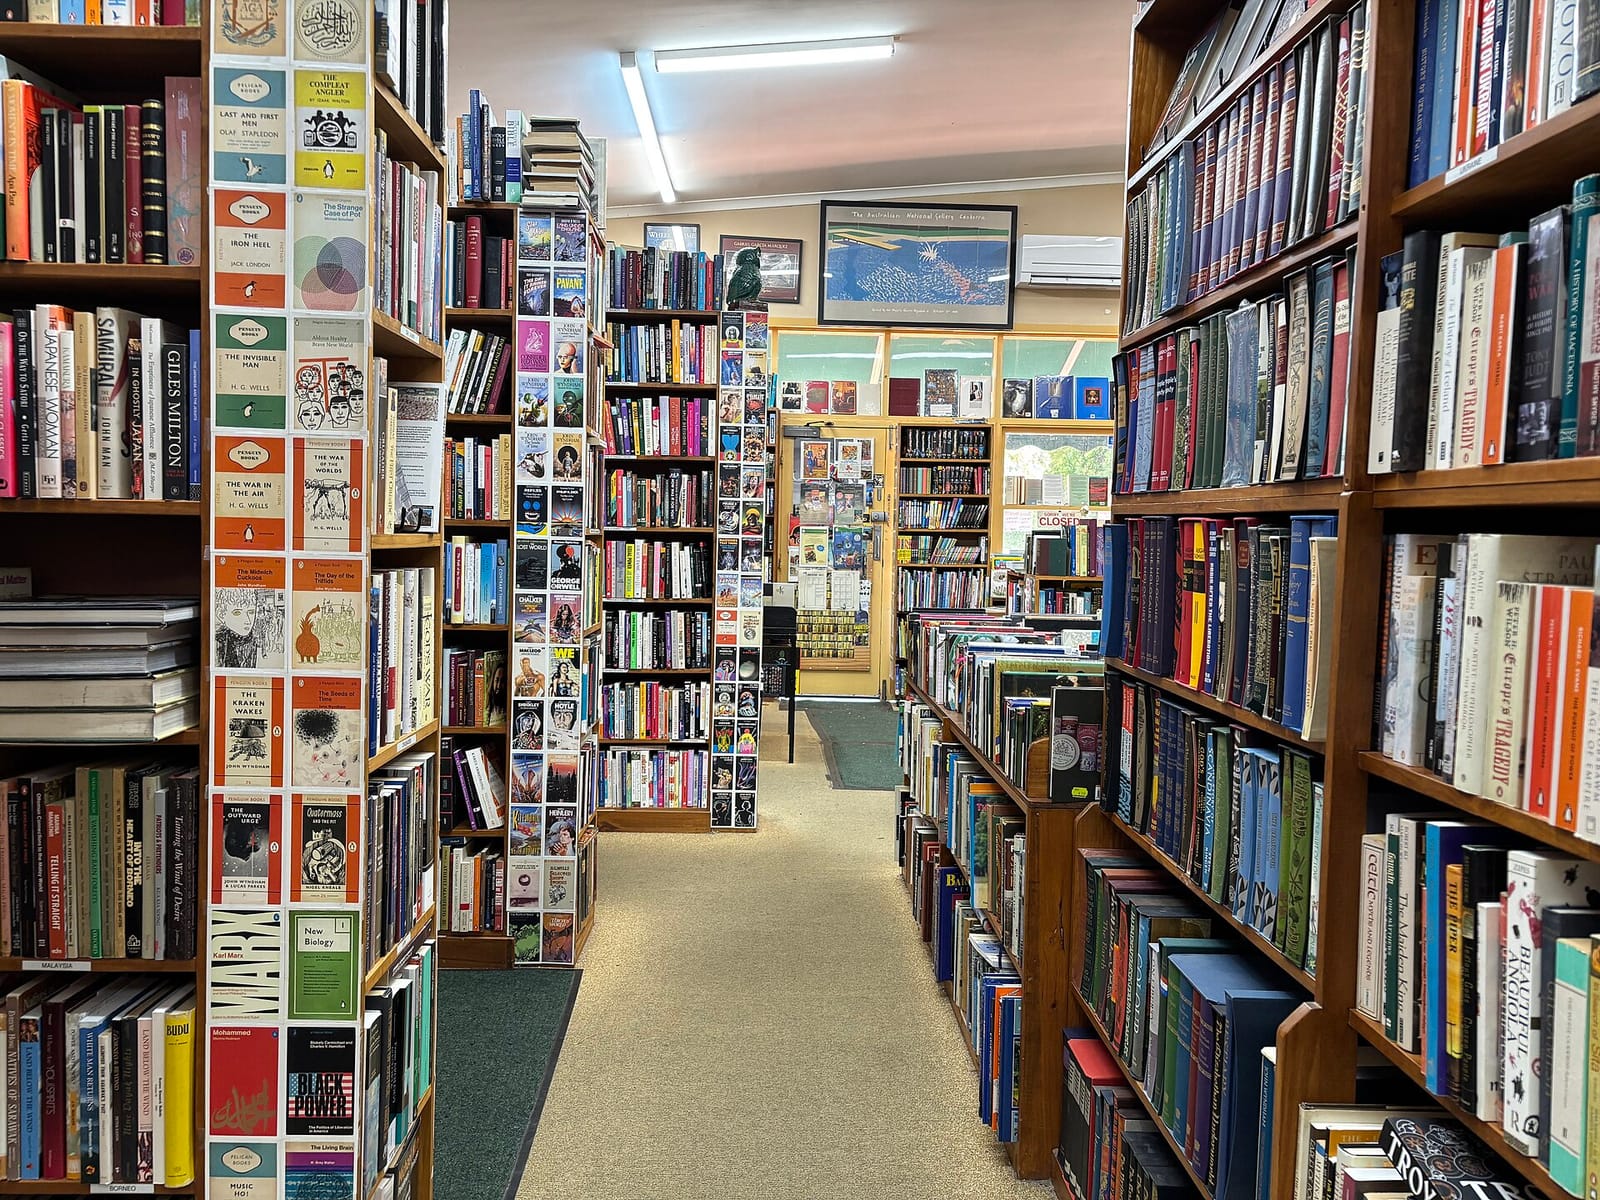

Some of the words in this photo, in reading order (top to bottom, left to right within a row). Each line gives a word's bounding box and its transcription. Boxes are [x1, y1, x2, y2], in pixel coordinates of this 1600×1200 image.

[1480, 12, 1495, 48] WAR
[1479, 49, 1493, 70] ON
[1476, 71, 1493, 137] UKRAINE
[1459, 156, 1483, 175] UKRAINE
[935, 213, 954, 221] Gallery
[1441, 245, 1449, 260] ONE
[1573, 259, 1581, 268] A
[556, 277, 583, 290] PAVANE
[1438, 261, 1448, 304] THOUSAND
[1570, 270, 1581, 313] HISTORY
[49, 317, 57, 330] THE
[1435, 306, 1445, 334] YEARS
[1570, 314, 1578, 328] OF
[44, 329, 58, 392] JAPANESE
[98, 318, 114, 387] SAMURAI
[1566, 330, 1577, 396] MACEDONIA
[132, 368, 139, 377] IN
[167, 350, 181, 397] GILES
[131, 379, 140, 418] GHOSTLY
[1590, 395, 1599, 426] SNYDER
[46, 398, 59, 459] WOMAN
[101, 417, 111, 438] JOHN
[168, 402, 182, 467] MILTON
[1460, 390, 1478, 452] TRAGEDY
[131, 421, 142, 461] JAPAN
[101, 447, 111, 467] MAN
[1040, 517, 1080, 526] CLOSED
[1504, 608, 1514, 649] WILSON
[554, 648, 574, 658] WE
[1591, 679, 1600, 704] THE
[1588, 709, 1598, 733] AGE
[1491, 719, 1514, 787] TRAGEDY
[1588, 739, 1596, 754] OF
[1204, 746, 1215, 837] SCANDINAVIA
[1582, 759, 1595, 812] EMPIRE
[307, 808, 342, 817] Quatermass
[126, 819, 134, 853] HEART
[173, 815, 184, 849] Taming
[126, 855, 134, 869] OF
[133, 841, 142, 866] INTO
[174, 850, 184, 861] the
[50, 855, 60, 884] TELLING
[134, 867, 142, 886] THE
[174, 863, 184, 886] Wind
[1367, 853, 1378, 899] celtic
[1512, 863, 1531, 875] ZIPES
[126, 870, 134, 907] BORNEO
[172, 887, 184, 895] of
[1449, 882, 1458, 910] THE
[51, 891, 61, 931] STRAIGHT
[173, 896, 184, 921] Desire
[1399, 893, 1409, 918] The
[305, 939, 334, 947] Biology
[1398, 923, 1409, 968] Maiden
[1449, 914, 1458, 953] PIPER
[1397, 979, 1408, 1013] King
[1507, 950, 1520, 1043] ANGIOLA
[1517, 944, 1532, 1058] BEAUTIFUL
[86, 1032, 94, 1056] WHITE
[166, 1023, 190, 1037] BUDU
[7, 1051, 18, 1086] NATIVES
[86, 1058, 94, 1077] MAN
[8, 1089, 17, 1101] OF
[86, 1078, 94, 1111] RETURNS
[298, 1073, 343, 1095] BLACK
[295, 1096, 346, 1117] POWER
[7, 1103, 18, 1144] SARAWAK
[1389, 1130, 1437, 1200] TROY
